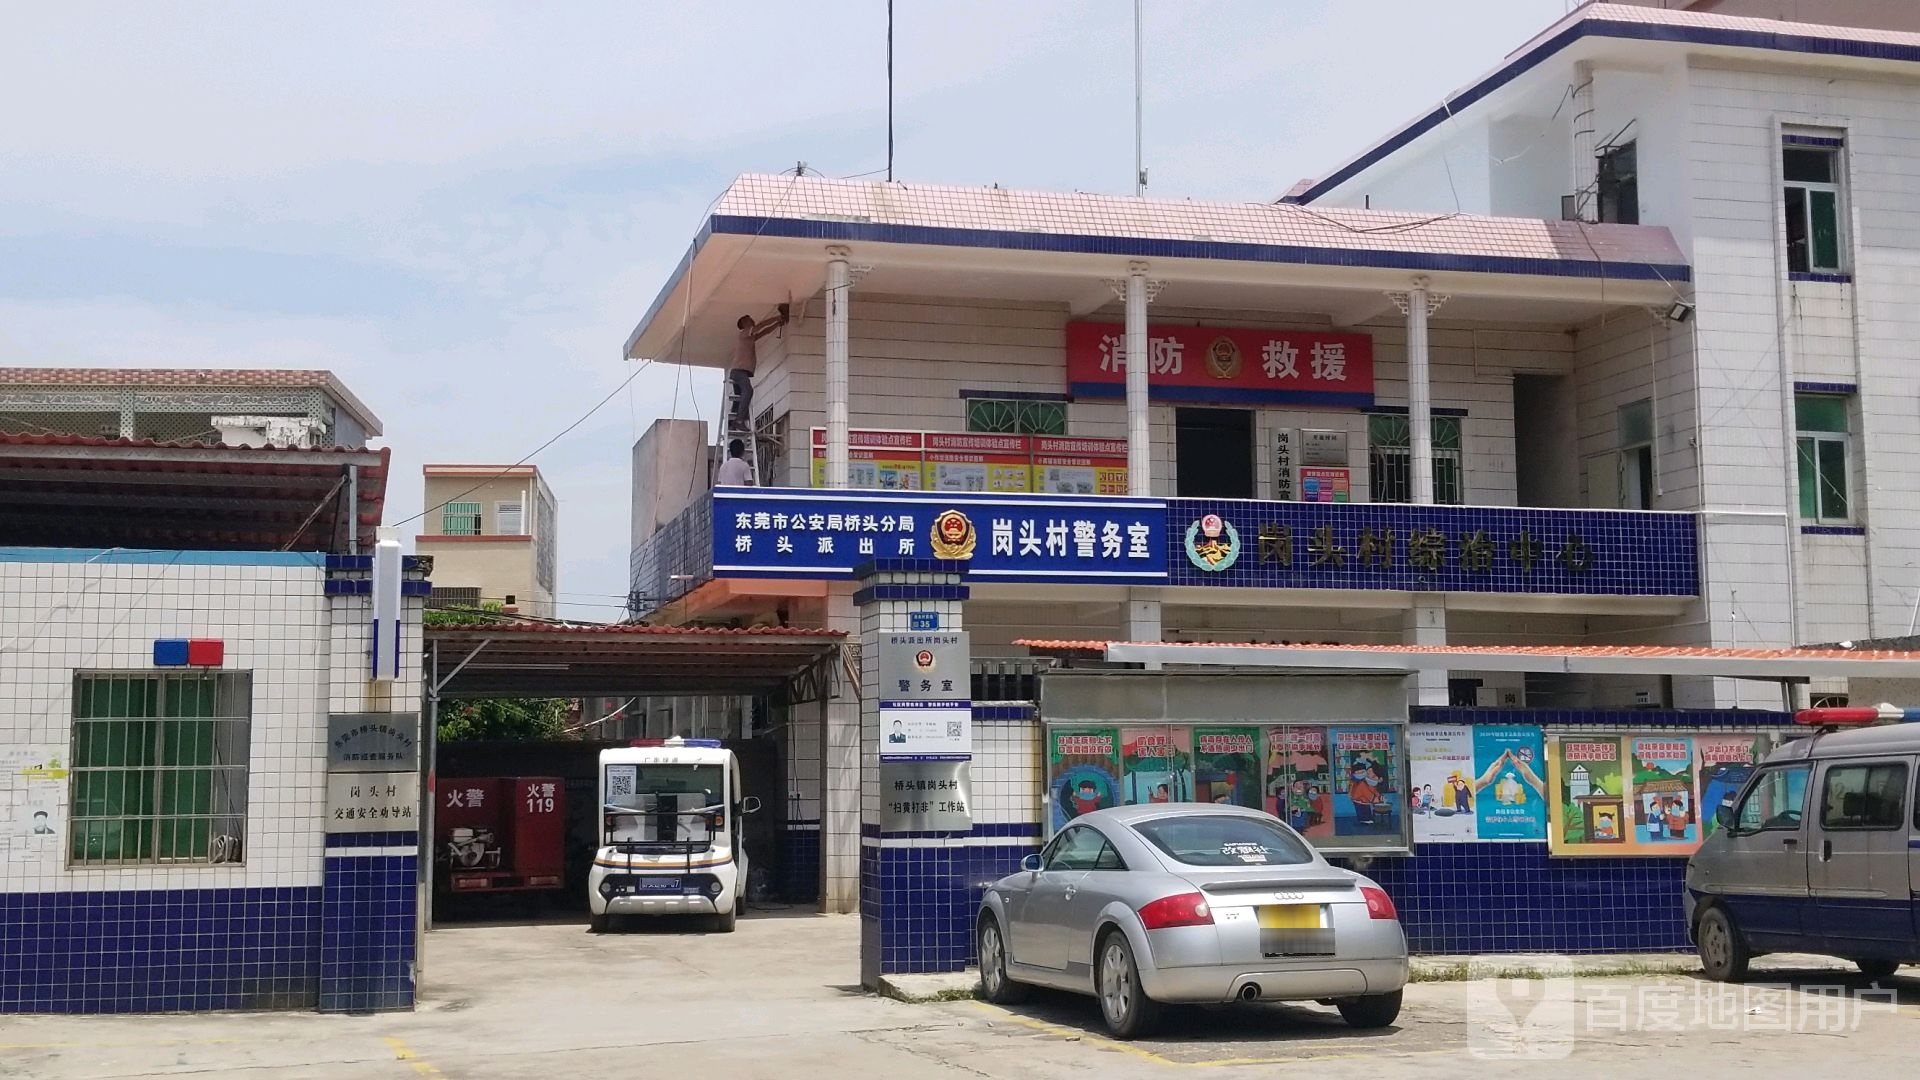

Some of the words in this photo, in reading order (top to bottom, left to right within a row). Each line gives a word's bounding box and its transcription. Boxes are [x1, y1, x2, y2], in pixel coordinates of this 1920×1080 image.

[1099, 334, 1184, 375] 消防
[1262, 340, 1347, 381] 救援
[735, 512, 914, 532] 东莞市公安局桥头分局
[735, 535, 914, 555] 桥头派出所
[992, 519, 1150, 558] 岗头村警务室
[891, 636, 958, 644] 桥头派出所岗头村
[898, 679, 953, 692] 警务室
[350, 785, 397, 798] 岗头村
[527, 783, 556, 798] 火警
[894, 780, 958, 790] 桥头镇岗头村
[446, 788, 485, 808] 火警
[527, 798, 554, 813] 119
[334, 806, 412, 819] 交通安全劝导站
